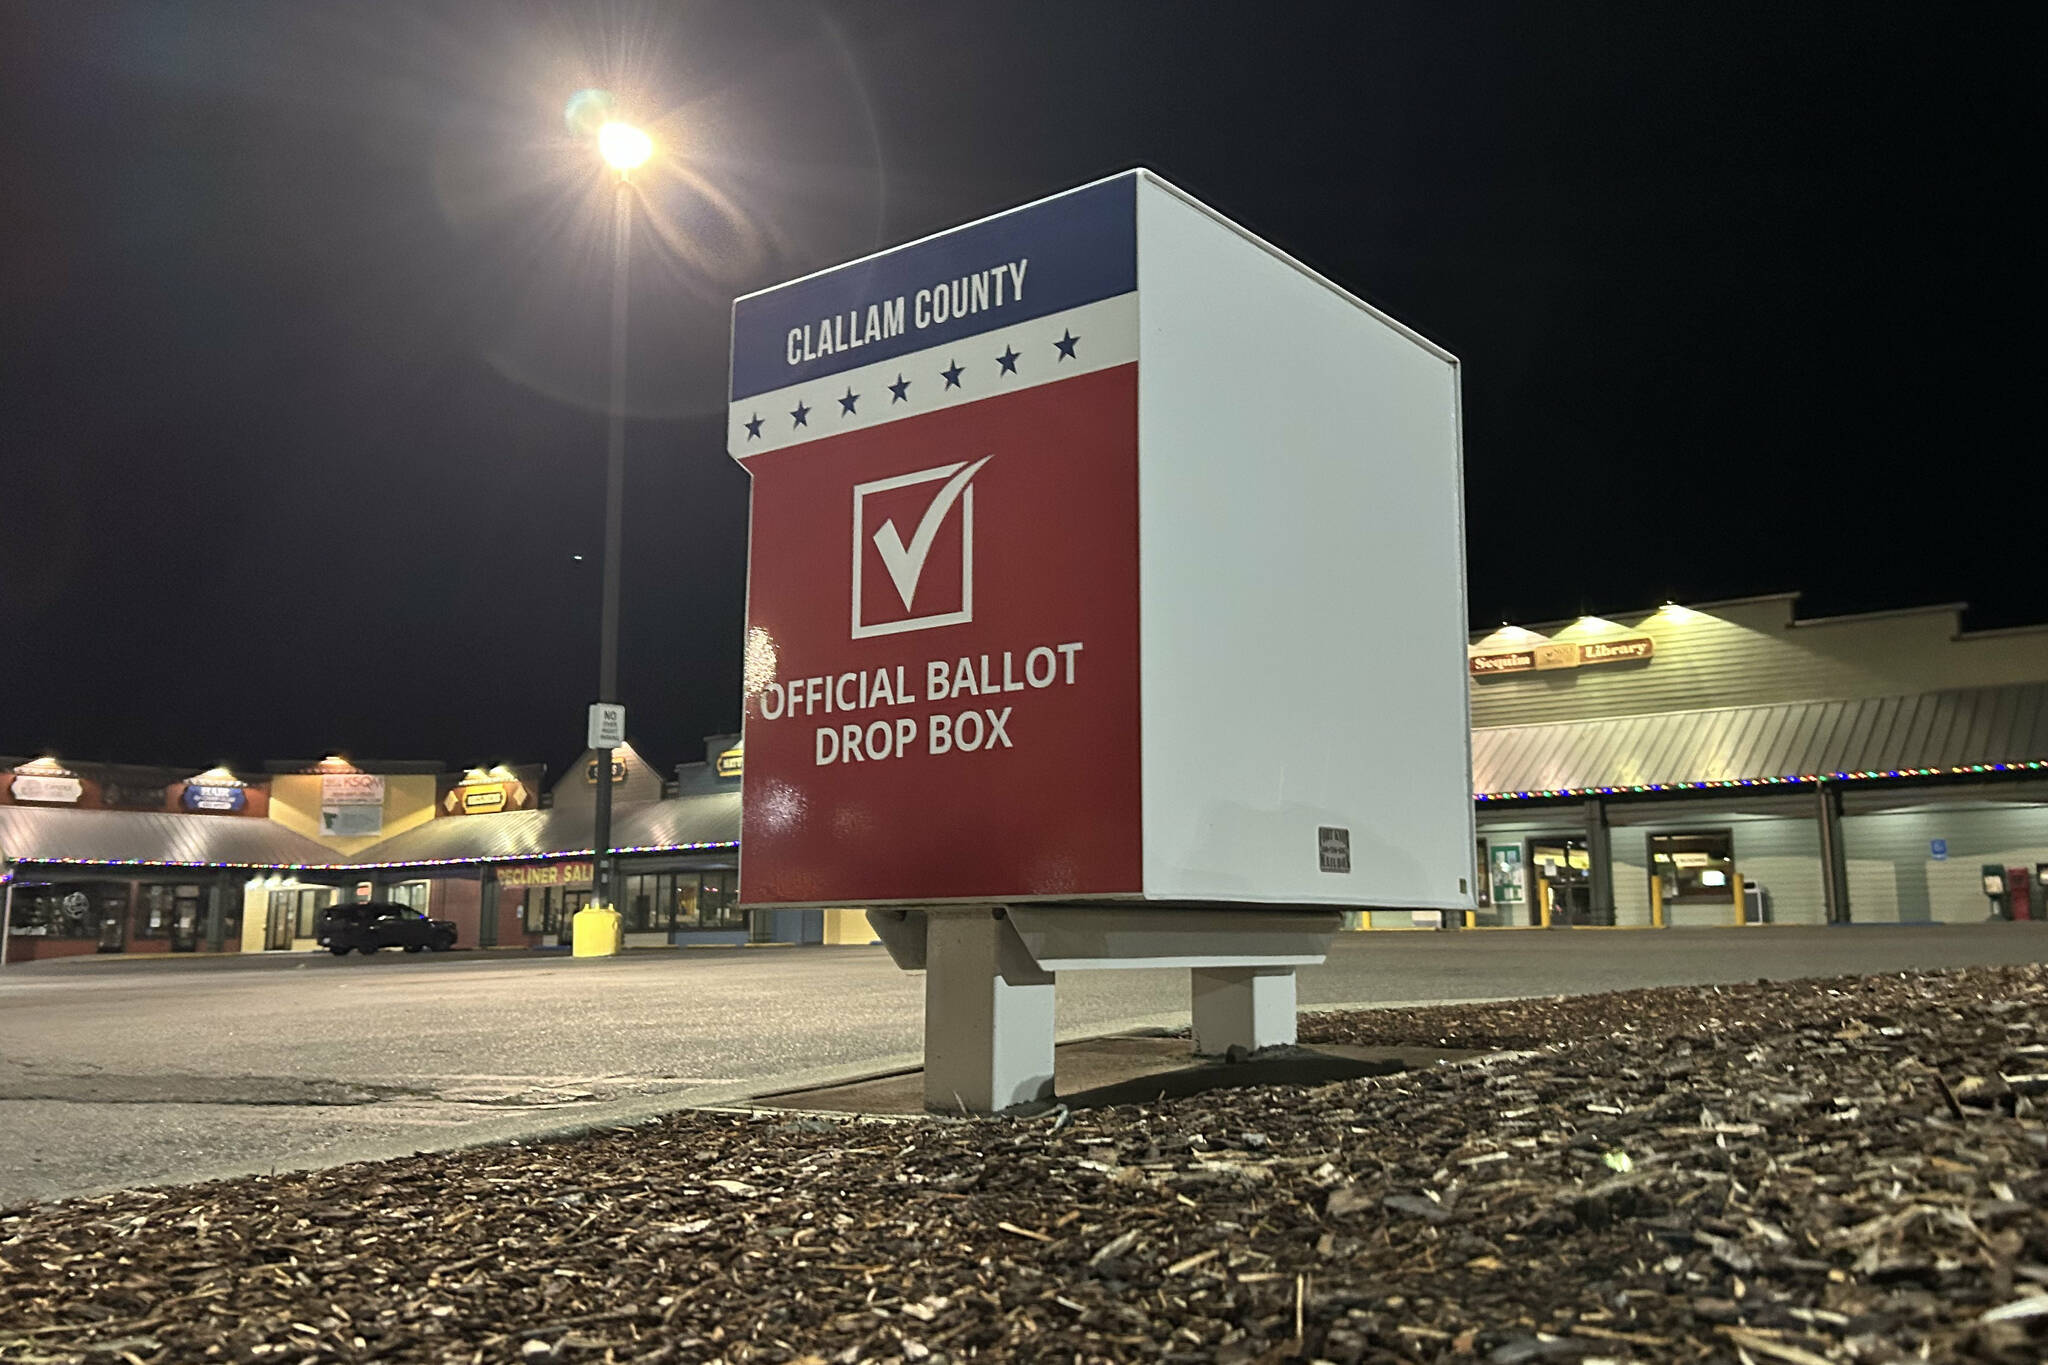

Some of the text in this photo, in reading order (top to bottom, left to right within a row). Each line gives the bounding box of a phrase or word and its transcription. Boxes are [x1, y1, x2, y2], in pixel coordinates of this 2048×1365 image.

[787, 258, 1029, 366] CLALLAM COUNTY
[760, 642, 1084, 721] OFFICIAL BALLOT
[1474, 655, 1531, 670] Sequim
[1585, 642, 1648, 658] Library
[603, 709, 618, 721] NO
[816, 706, 1014, 766] DROP BOX
